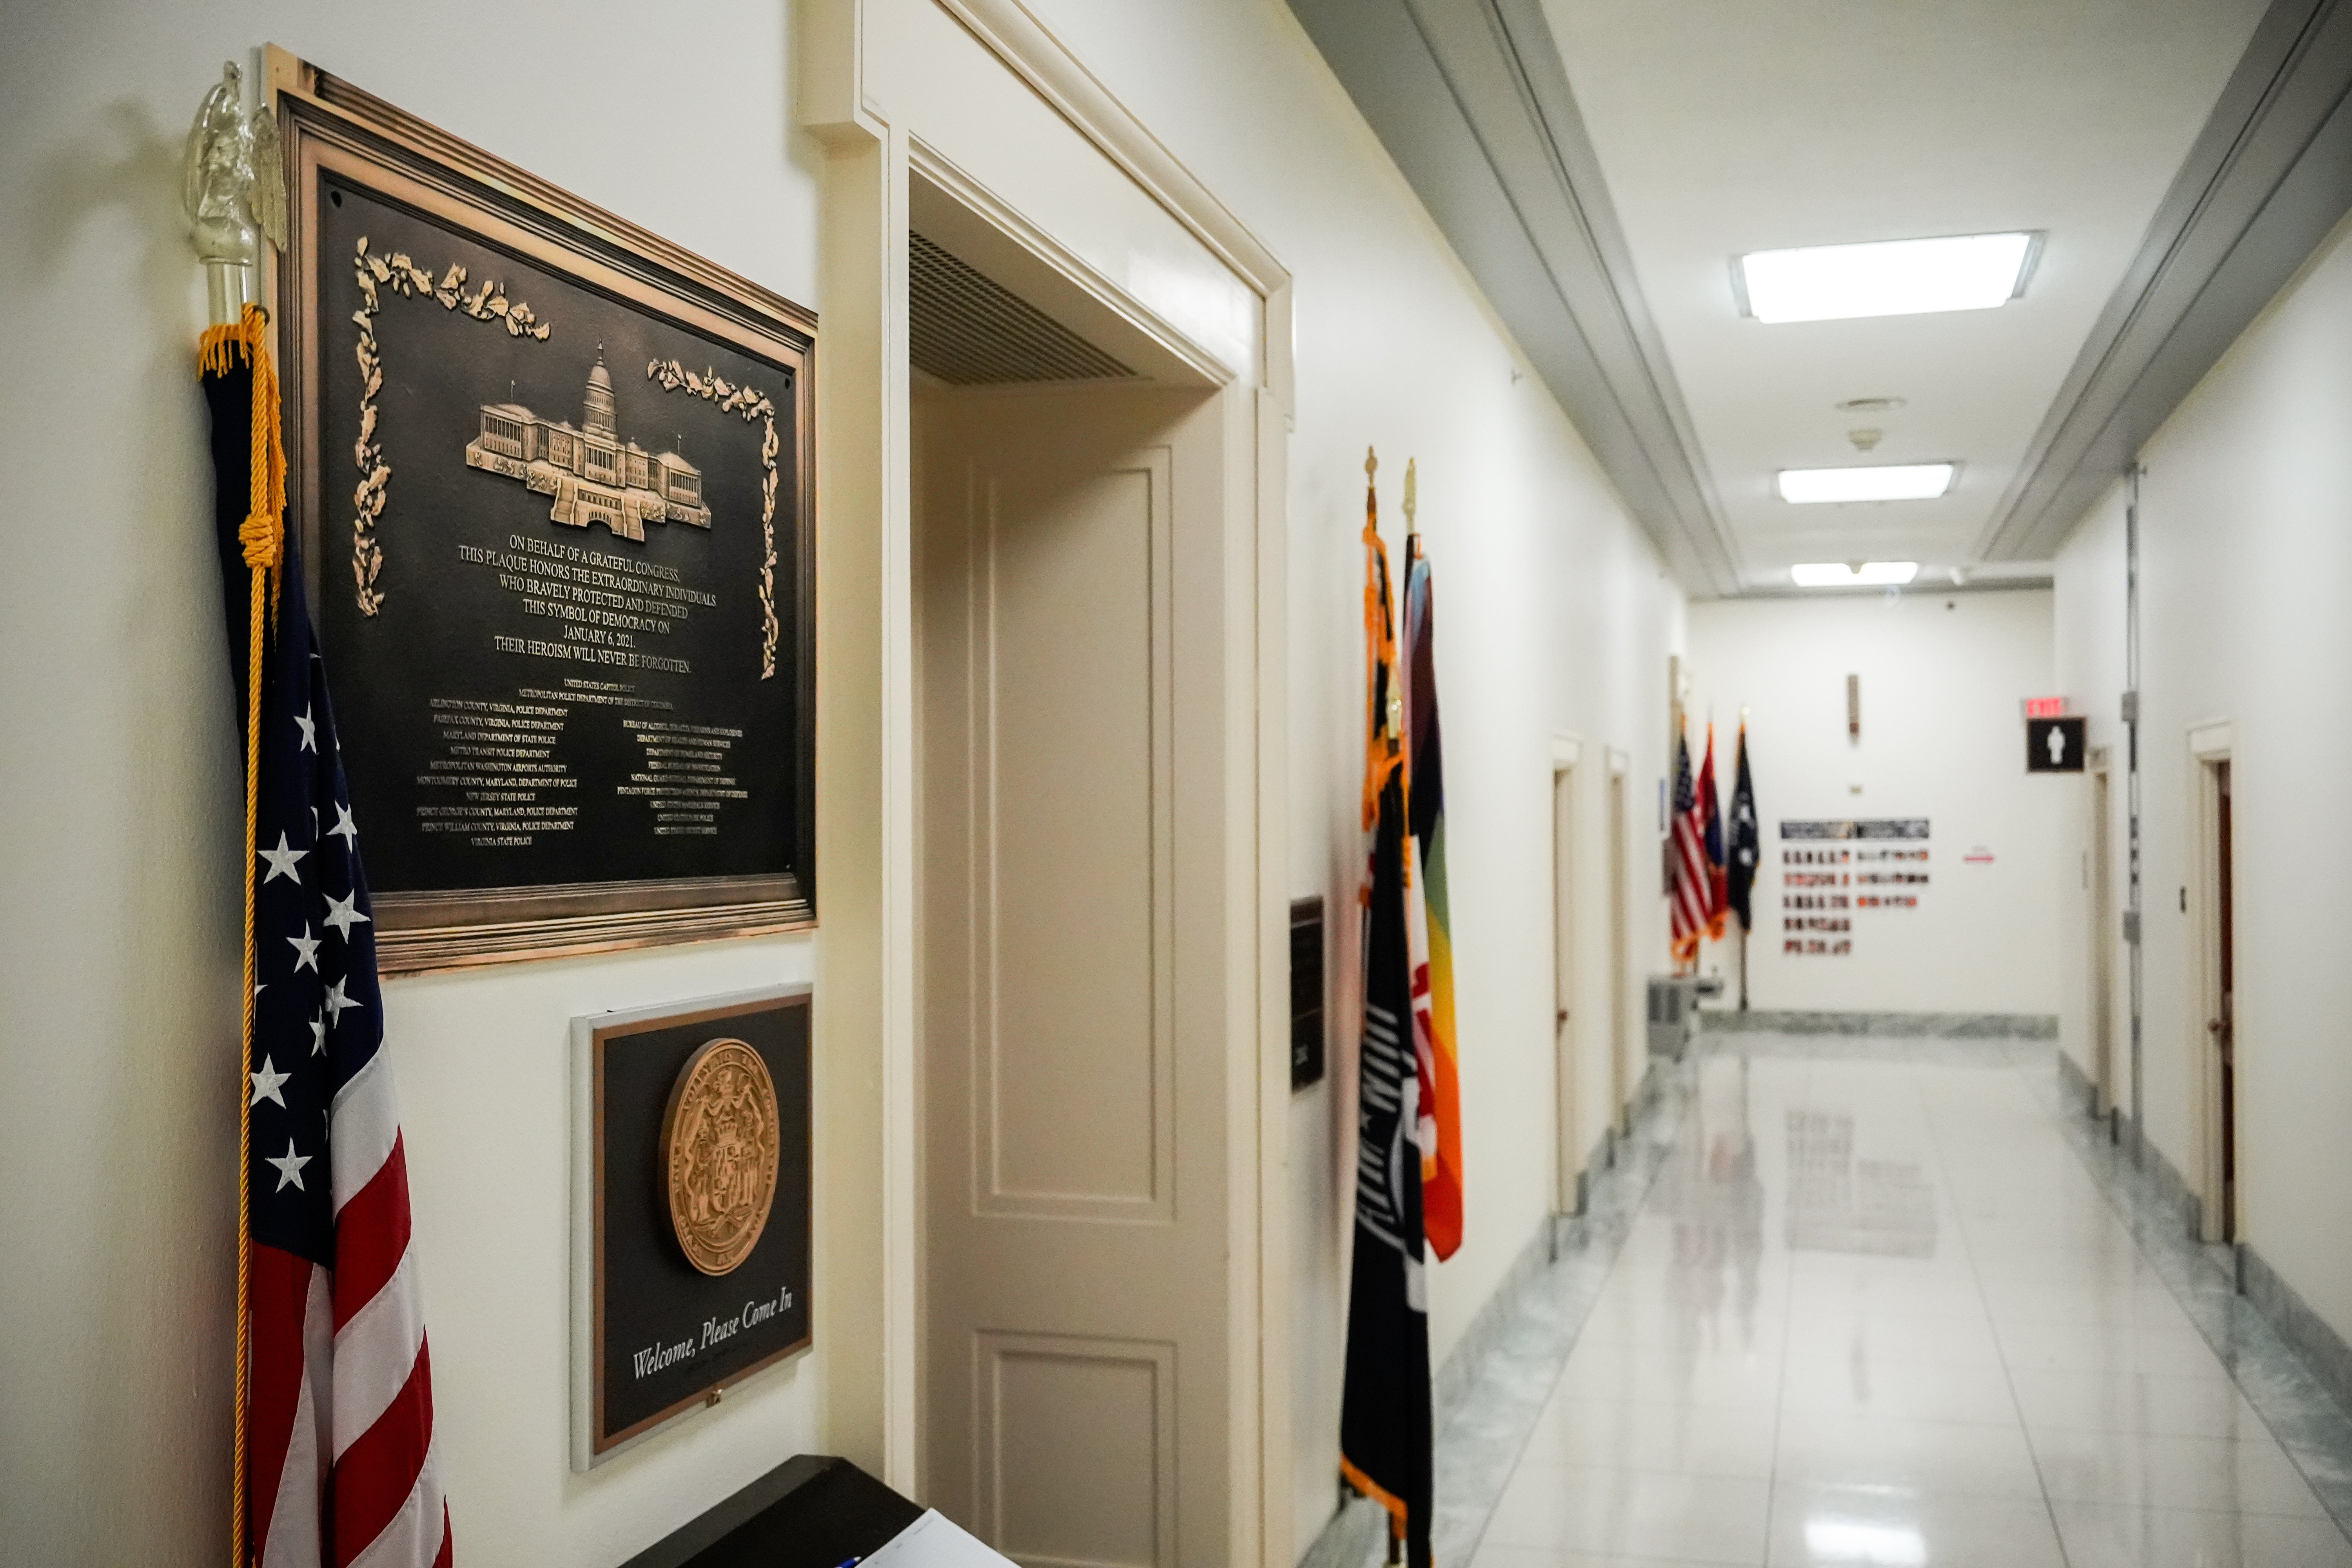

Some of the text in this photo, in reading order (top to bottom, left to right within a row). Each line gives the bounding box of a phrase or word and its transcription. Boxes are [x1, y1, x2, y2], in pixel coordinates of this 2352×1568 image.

[510, 535, 524, 550] ON
[527, 538, 565, 558] BEHALF
[568, 546, 579, 561] OF
[581, 551, 588, 563] A
[590, 552, 634, 572] GRATEFUL
[459, 545, 716, 606] THIS PLAQUE HONORS THE EXTRAORDINARY INDIVIDUALS
[500, 574, 688, 619] WHO BRAVELY PROTECTED AND DEFENDED
[523, 599, 669, 633] THIS SYMBOL OF DEMOCRACY ON
[494, 636, 525, 653] THEIR
[528, 640, 571, 659] HEROISM
[573, 646, 596, 662] WILL
[598, 650, 627, 665] NEVER
[629, 653, 639, 667] BE
[564, 625, 606, 644] JANUARY
[608, 632, 614, 646] 6,
[583, 681, 599, 690] STATES
[633, 1286, 792, 1379] Welcome, Please Come In
